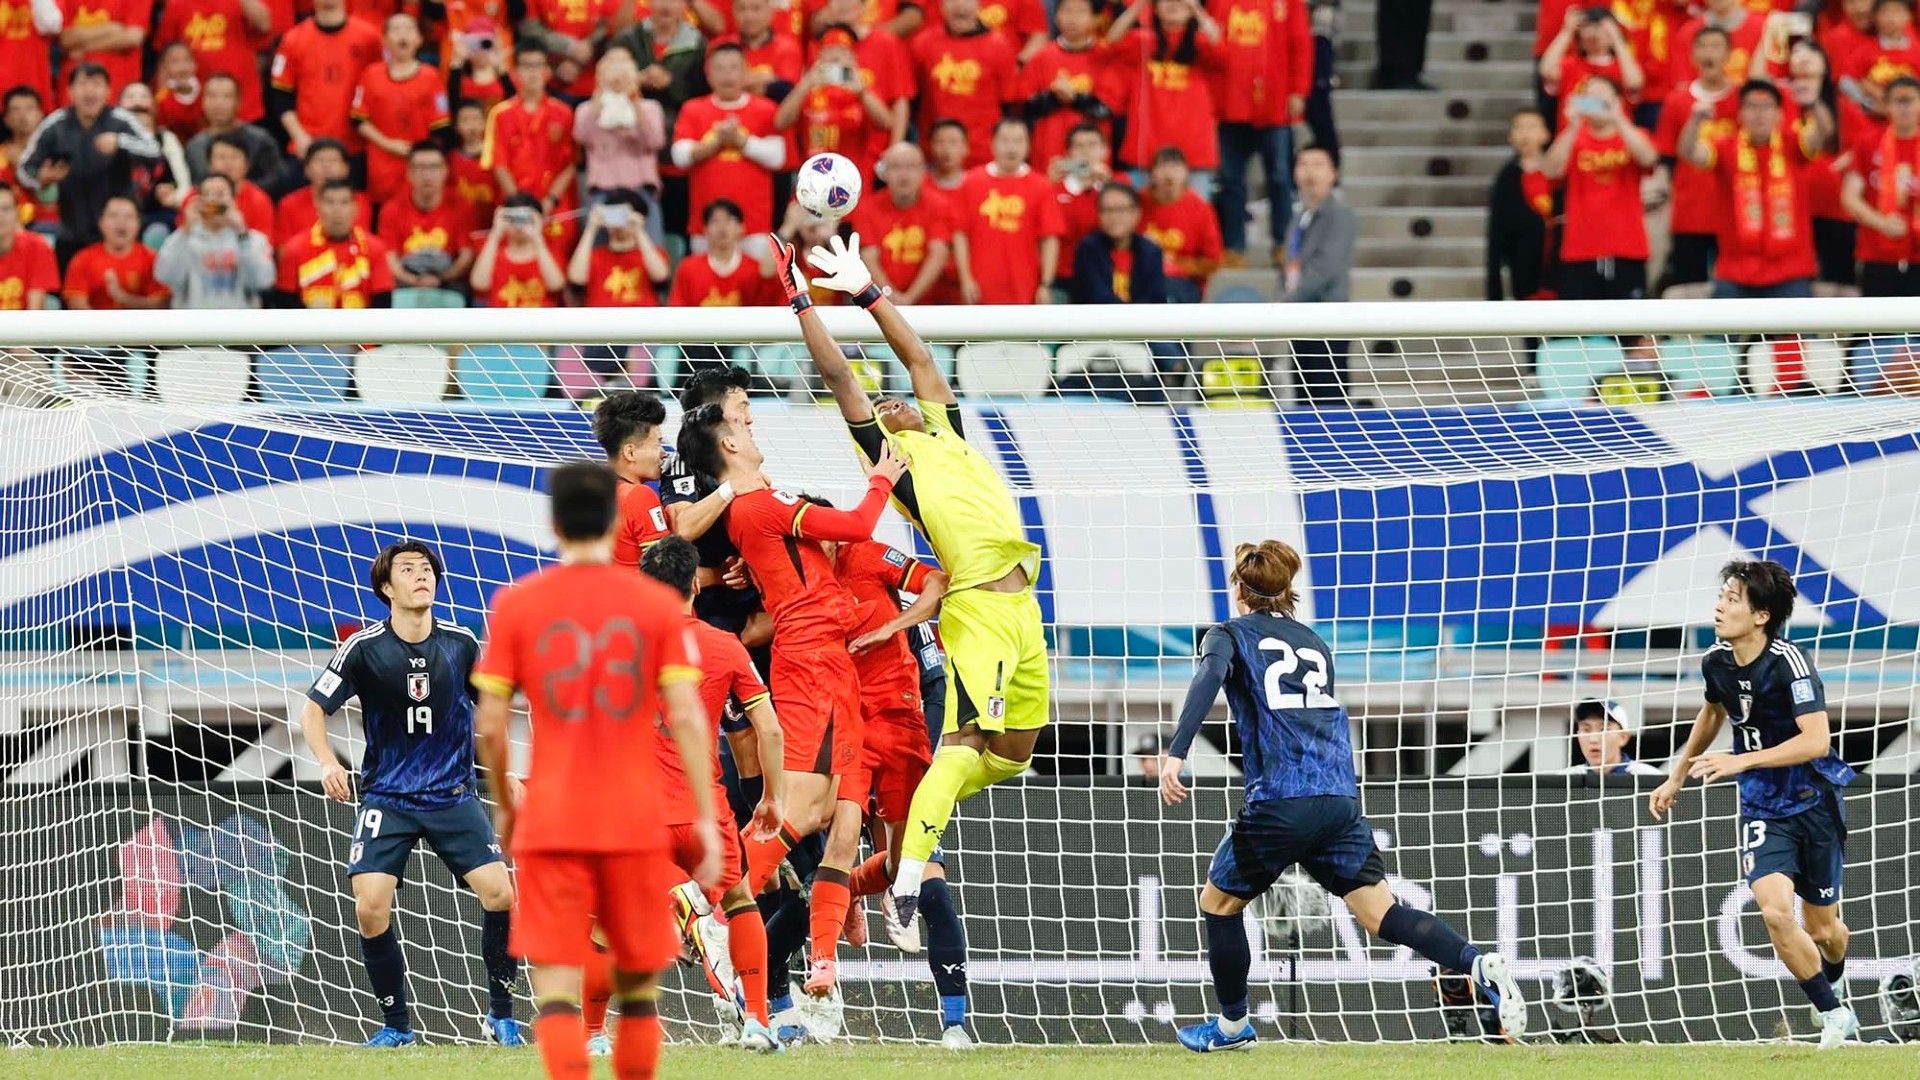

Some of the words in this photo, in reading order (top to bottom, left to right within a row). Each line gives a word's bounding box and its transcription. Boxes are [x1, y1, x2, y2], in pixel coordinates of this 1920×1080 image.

[537, 617, 644, 720] 23
[1258, 637, 1340, 709] 22
[406, 706, 433, 735] 19
[1738, 726, 1763, 751] 13
[355, 808, 383, 839] 19
[1742, 820, 1767, 852] 13
